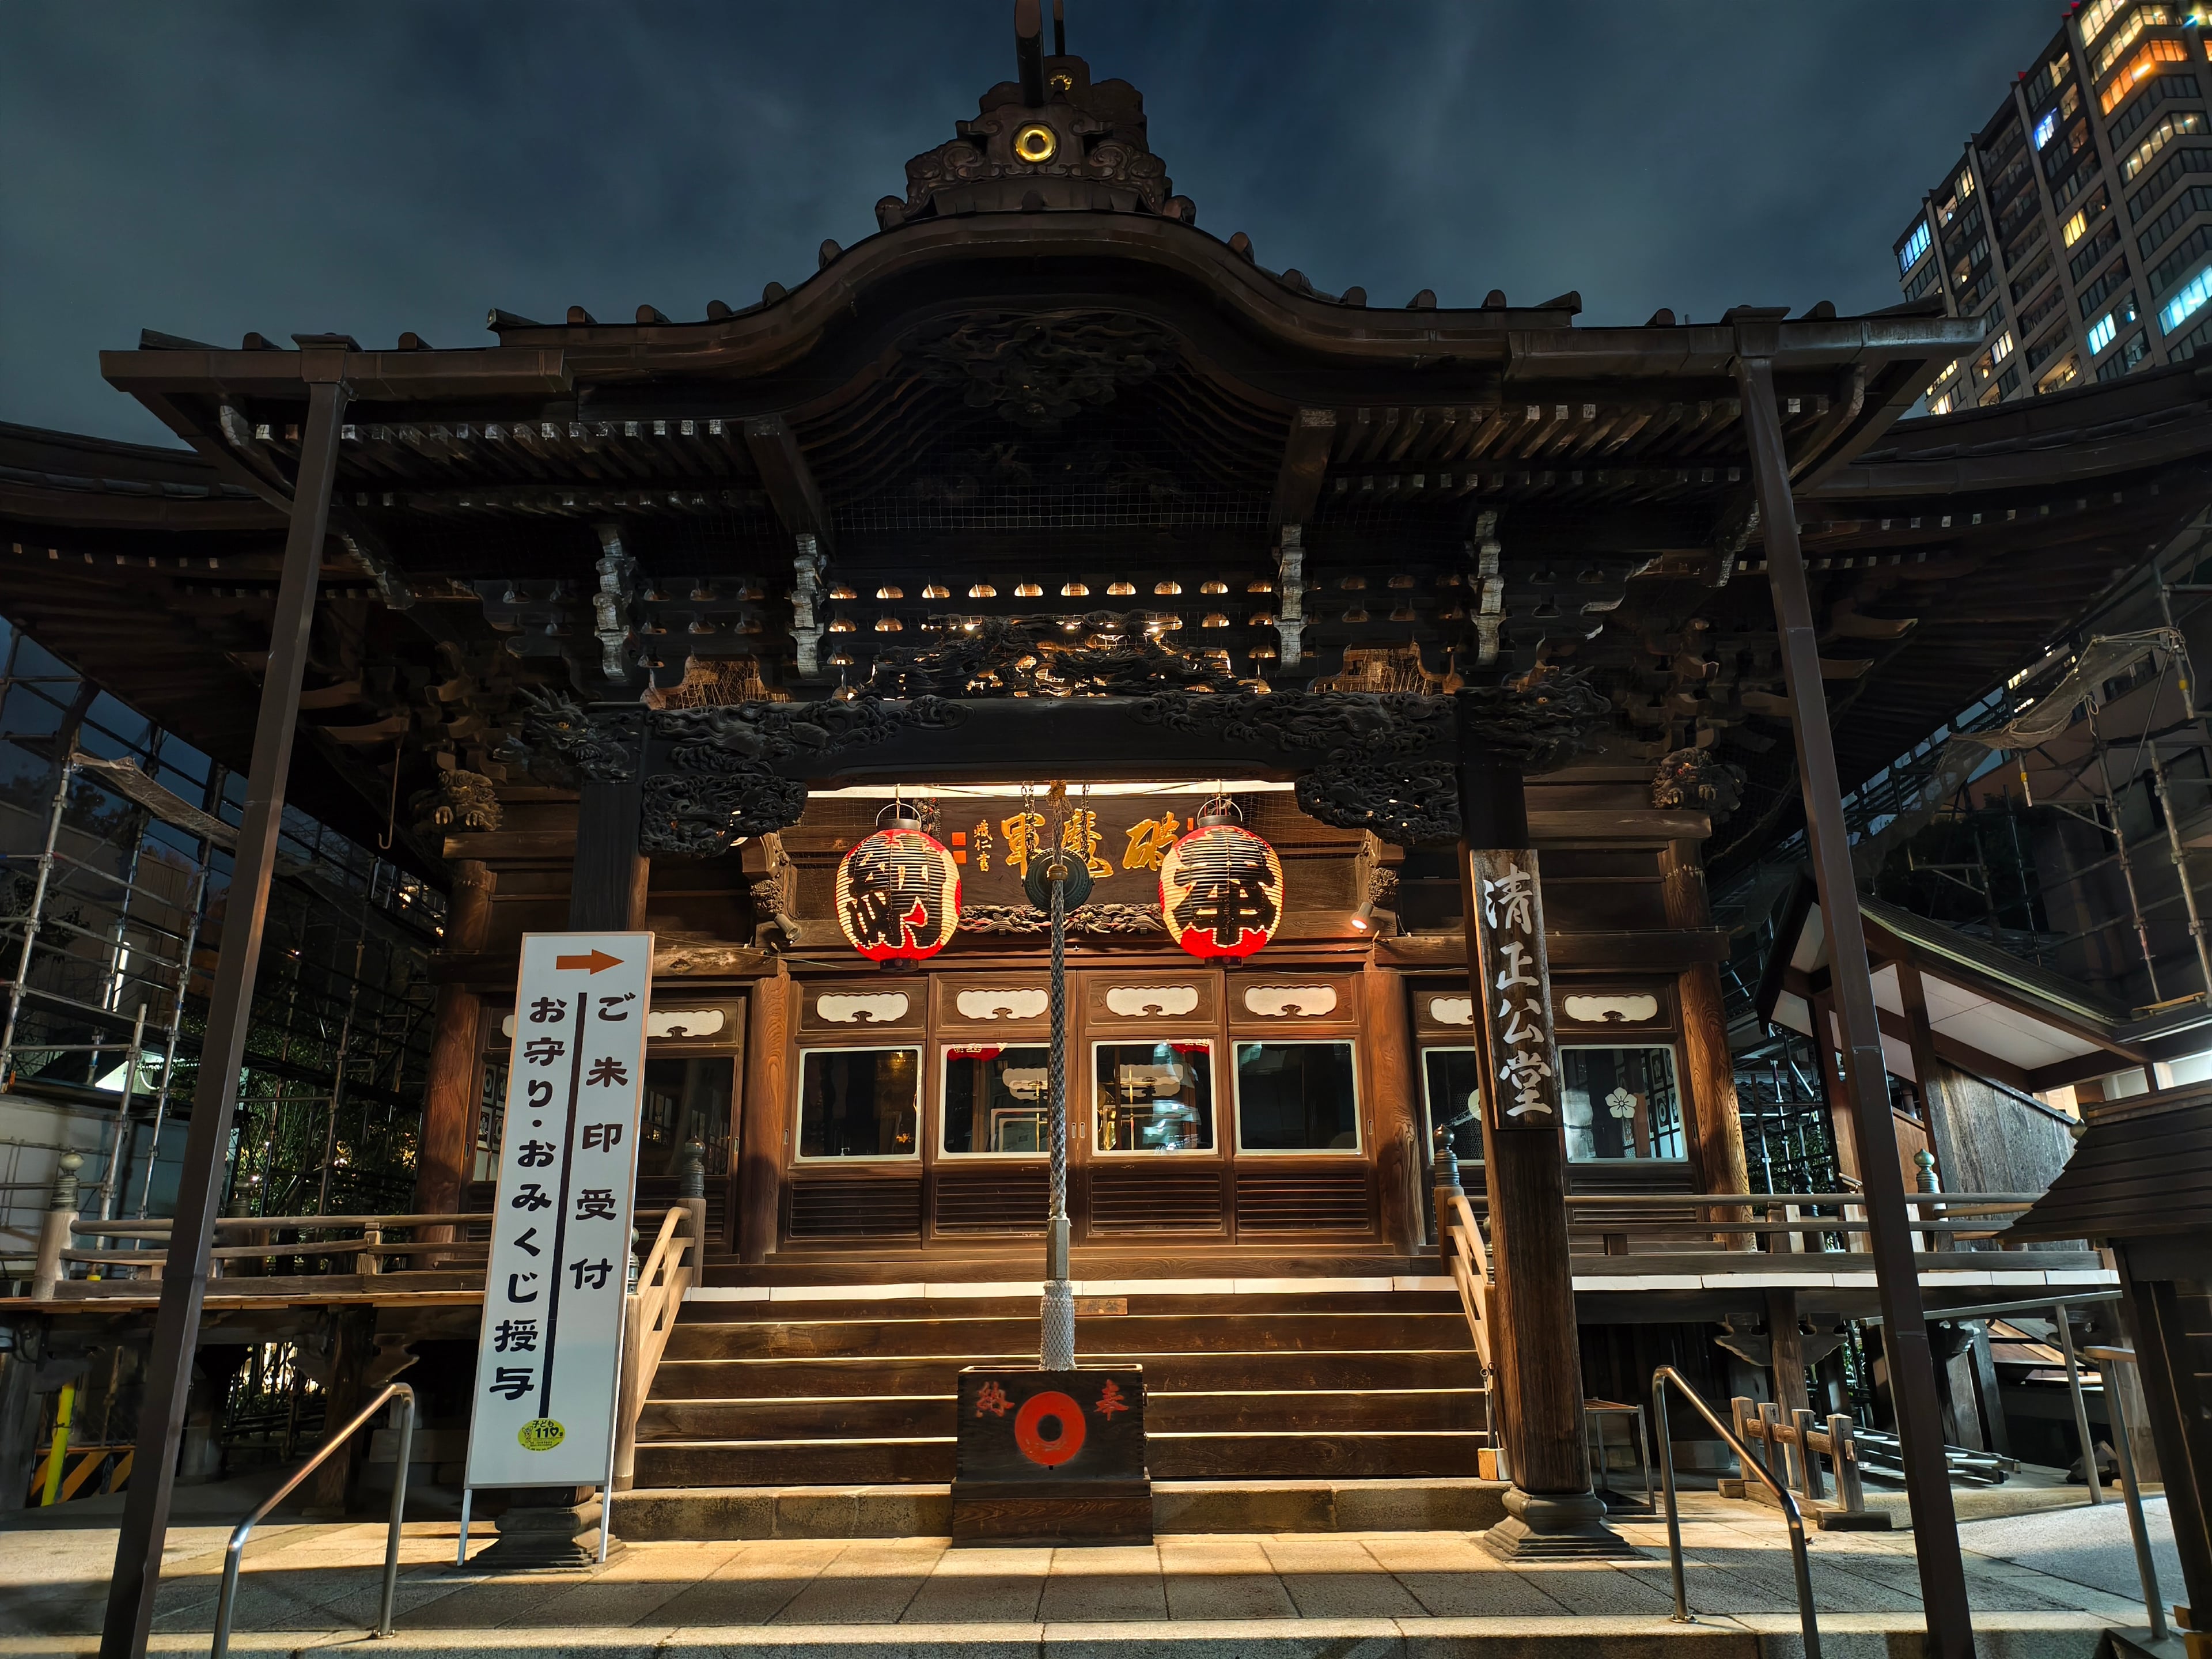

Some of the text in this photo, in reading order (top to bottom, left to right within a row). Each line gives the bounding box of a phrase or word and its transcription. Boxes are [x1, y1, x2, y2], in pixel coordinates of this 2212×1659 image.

[1483, 863, 1552, 1117] 清正公堂
[489, 997, 567, 1400] お守り・おみくじ授与
[569, 992, 636, 1290] ご朱印受付
[532, 1420, 554, 1428] 子ども
